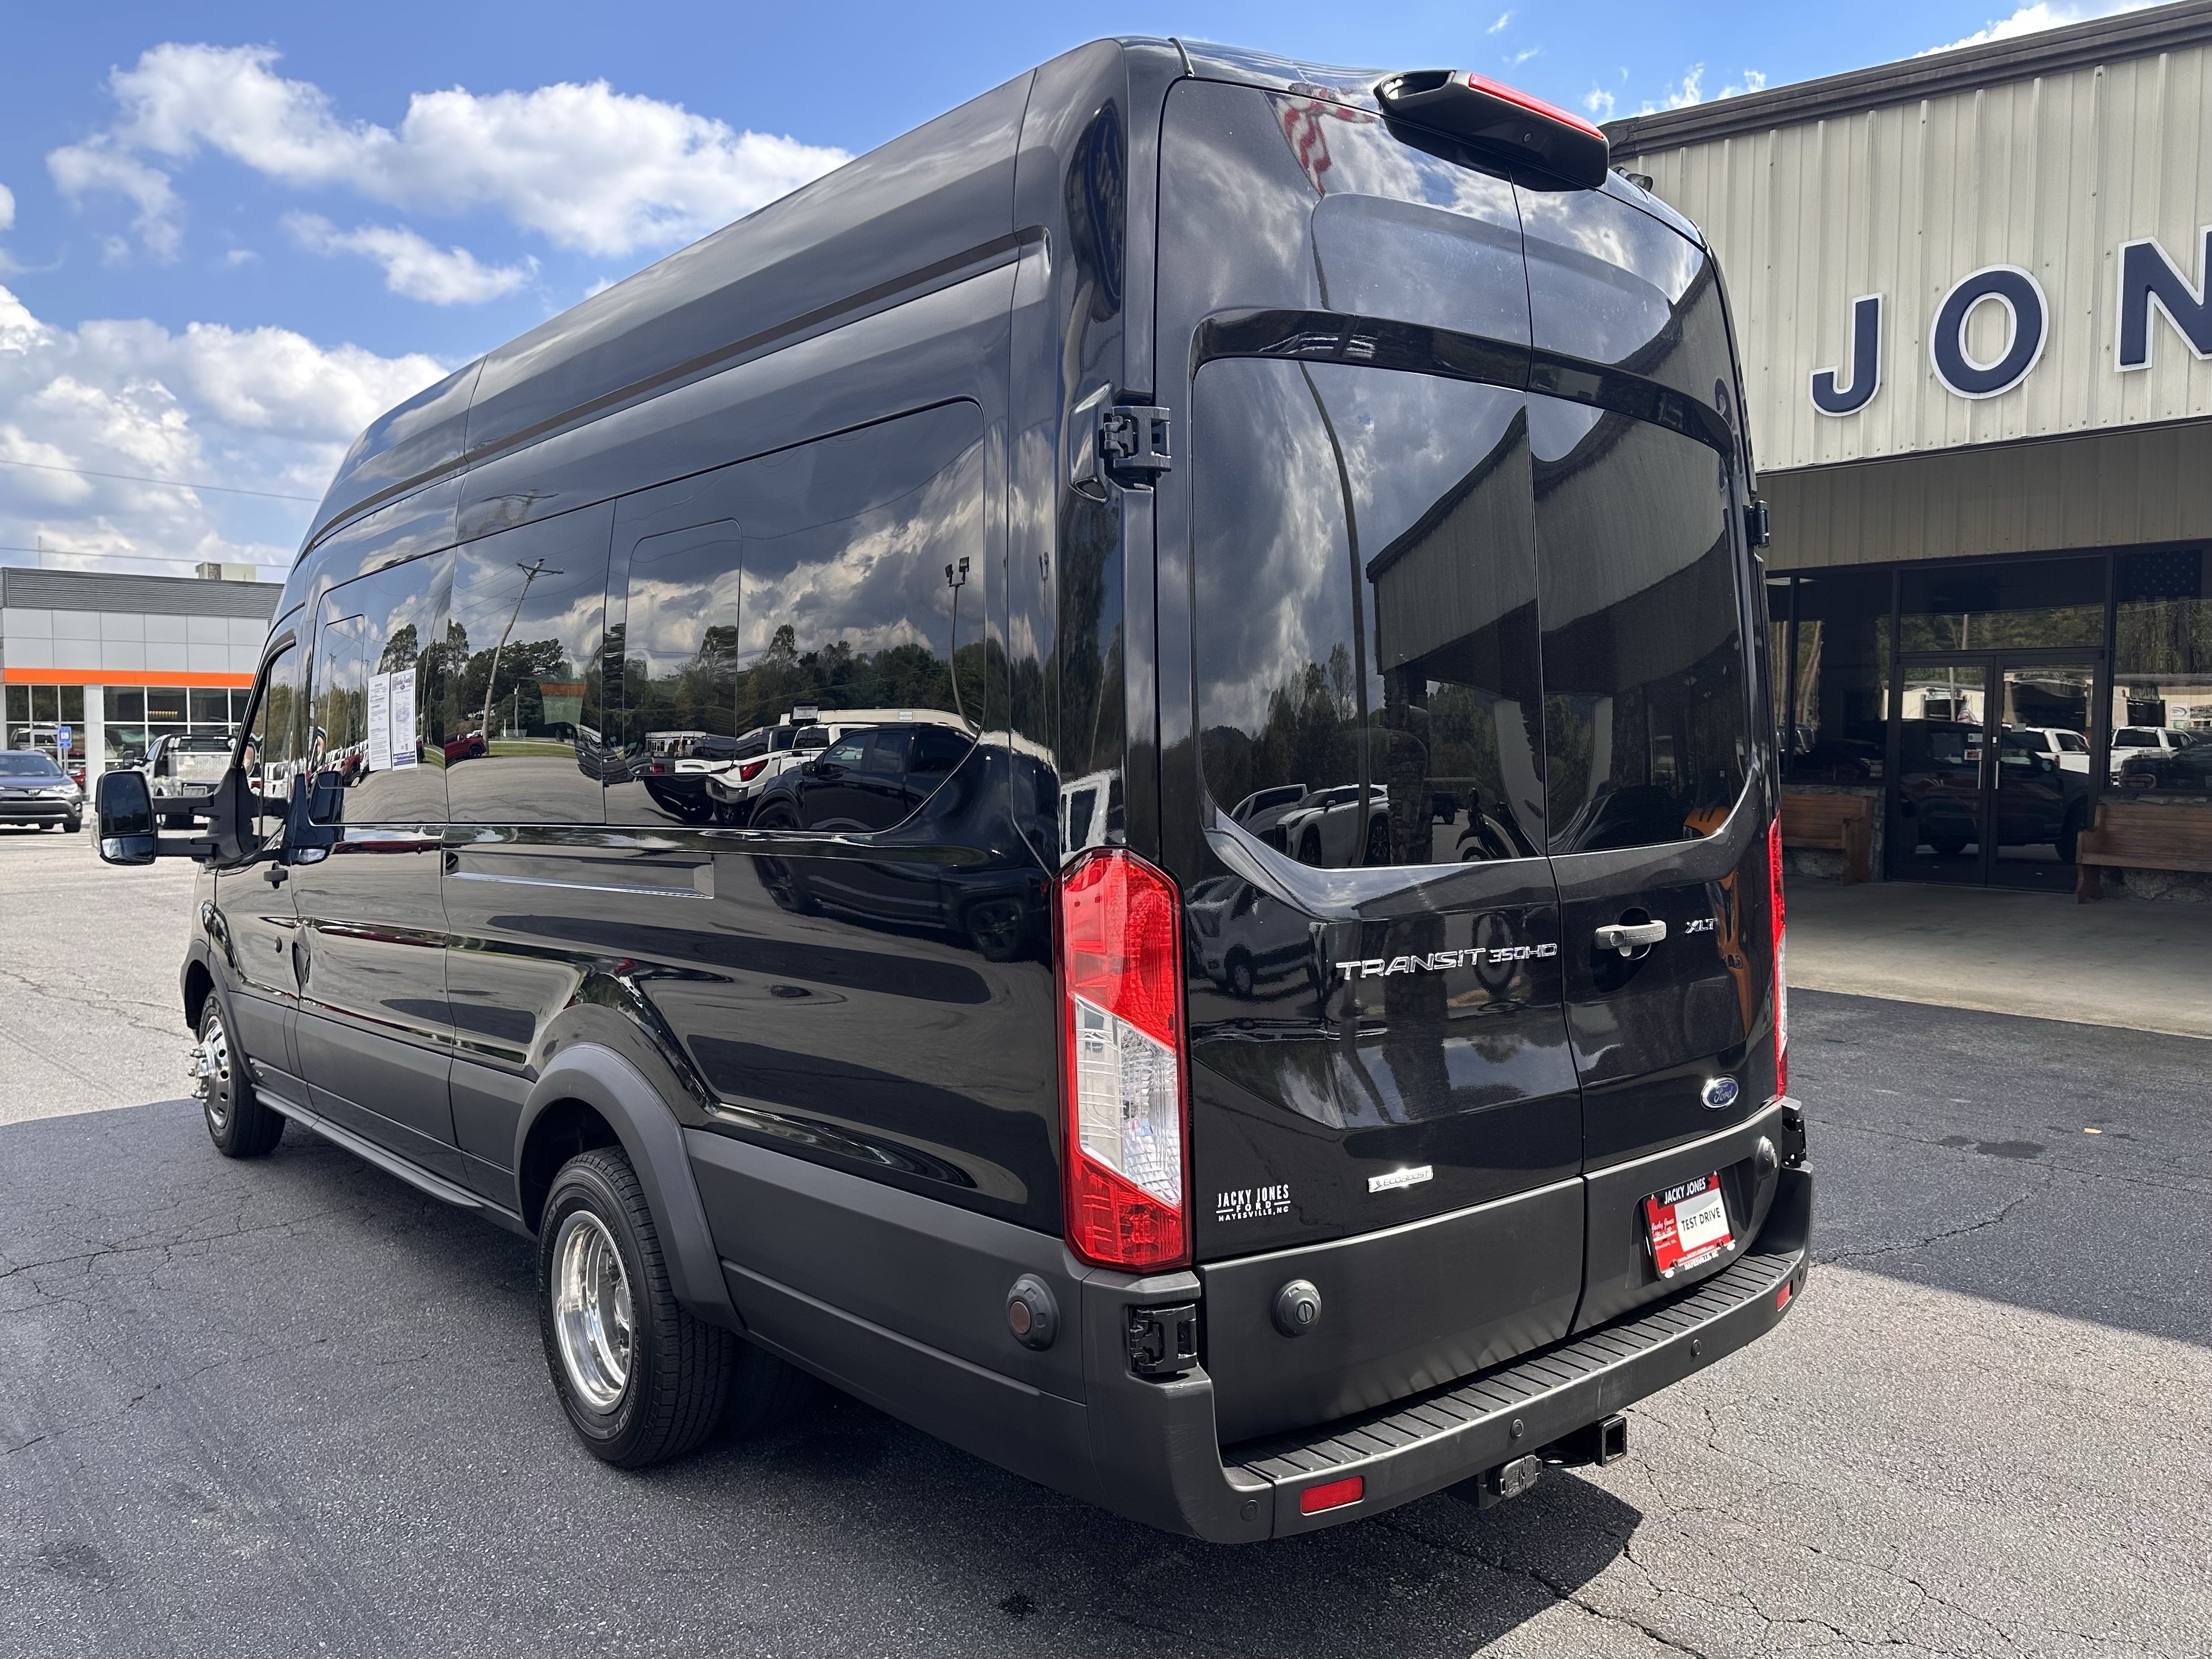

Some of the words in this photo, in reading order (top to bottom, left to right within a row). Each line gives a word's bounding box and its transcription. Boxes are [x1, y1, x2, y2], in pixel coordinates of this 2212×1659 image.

[1684, 918, 1718, 934] XLT
[1336, 948, 1486, 980] TRANSIT
[1488, 943, 1558, 963] 350HD
[1383, 1171, 1429, 1186] ECOBOOST
[1664, 1185, 1684, 1204] JACKY
[1686, 1177, 1706, 1196] JONES
[1217, 1189, 1252, 1208] JACKY
[1257, 1184, 1289, 1203] JONES
[1236, 1201, 1271, 1213] FORD
[1681, 1216, 1698, 1231] TEST
[1699, 1207, 1721, 1225] DRIVE
